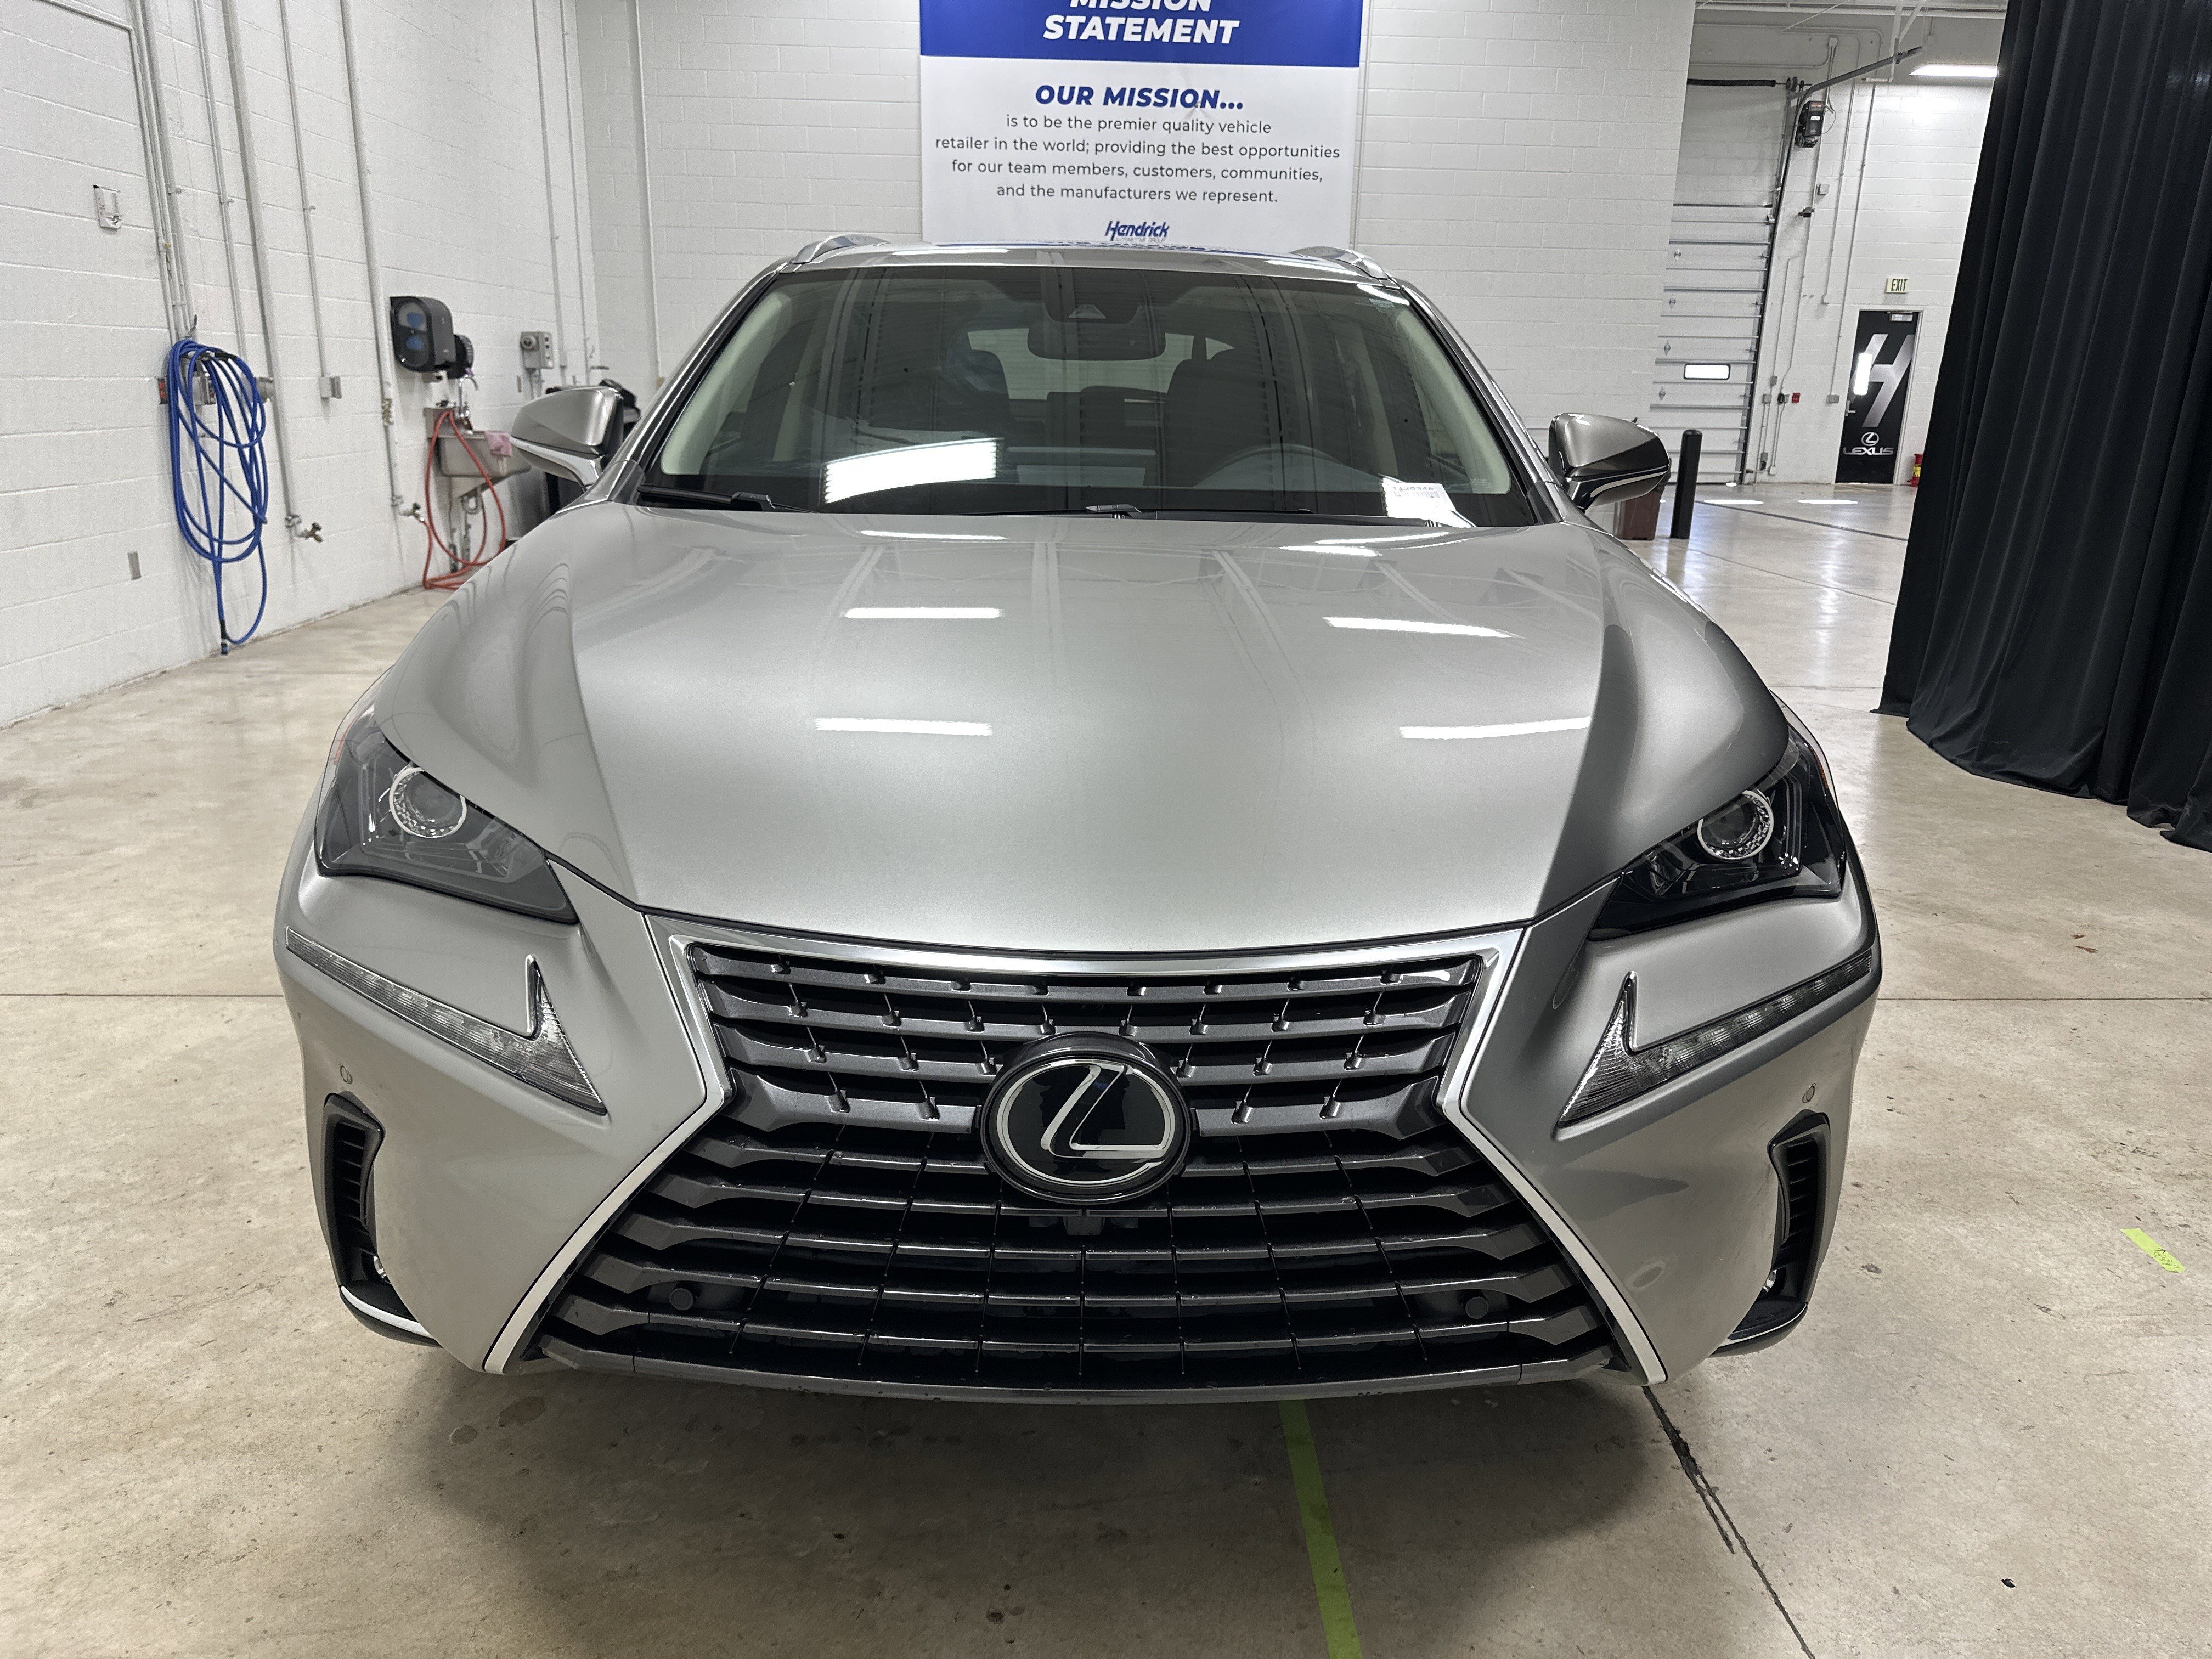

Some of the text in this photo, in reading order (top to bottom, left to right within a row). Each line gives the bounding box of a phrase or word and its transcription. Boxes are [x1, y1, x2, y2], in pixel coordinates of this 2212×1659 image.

[1043, 15, 1240, 44] STATEMENT
[1035, 84, 1244, 110] OUR MISSION...
[1007, 114, 1271, 136] is to be the premier quality vehicle
[935, 136, 1340, 160] retailer in the world; providing the best opportunities
[951, 159, 1322, 183] for our team members, customers, communities,
[997, 184, 1278, 204] and the manufacturers we represent.
[1104, 221, 1170, 241] Hendrick
[1891, 278, 1908, 291] EXIT
[1843, 447, 1894, 455] LEXUS
